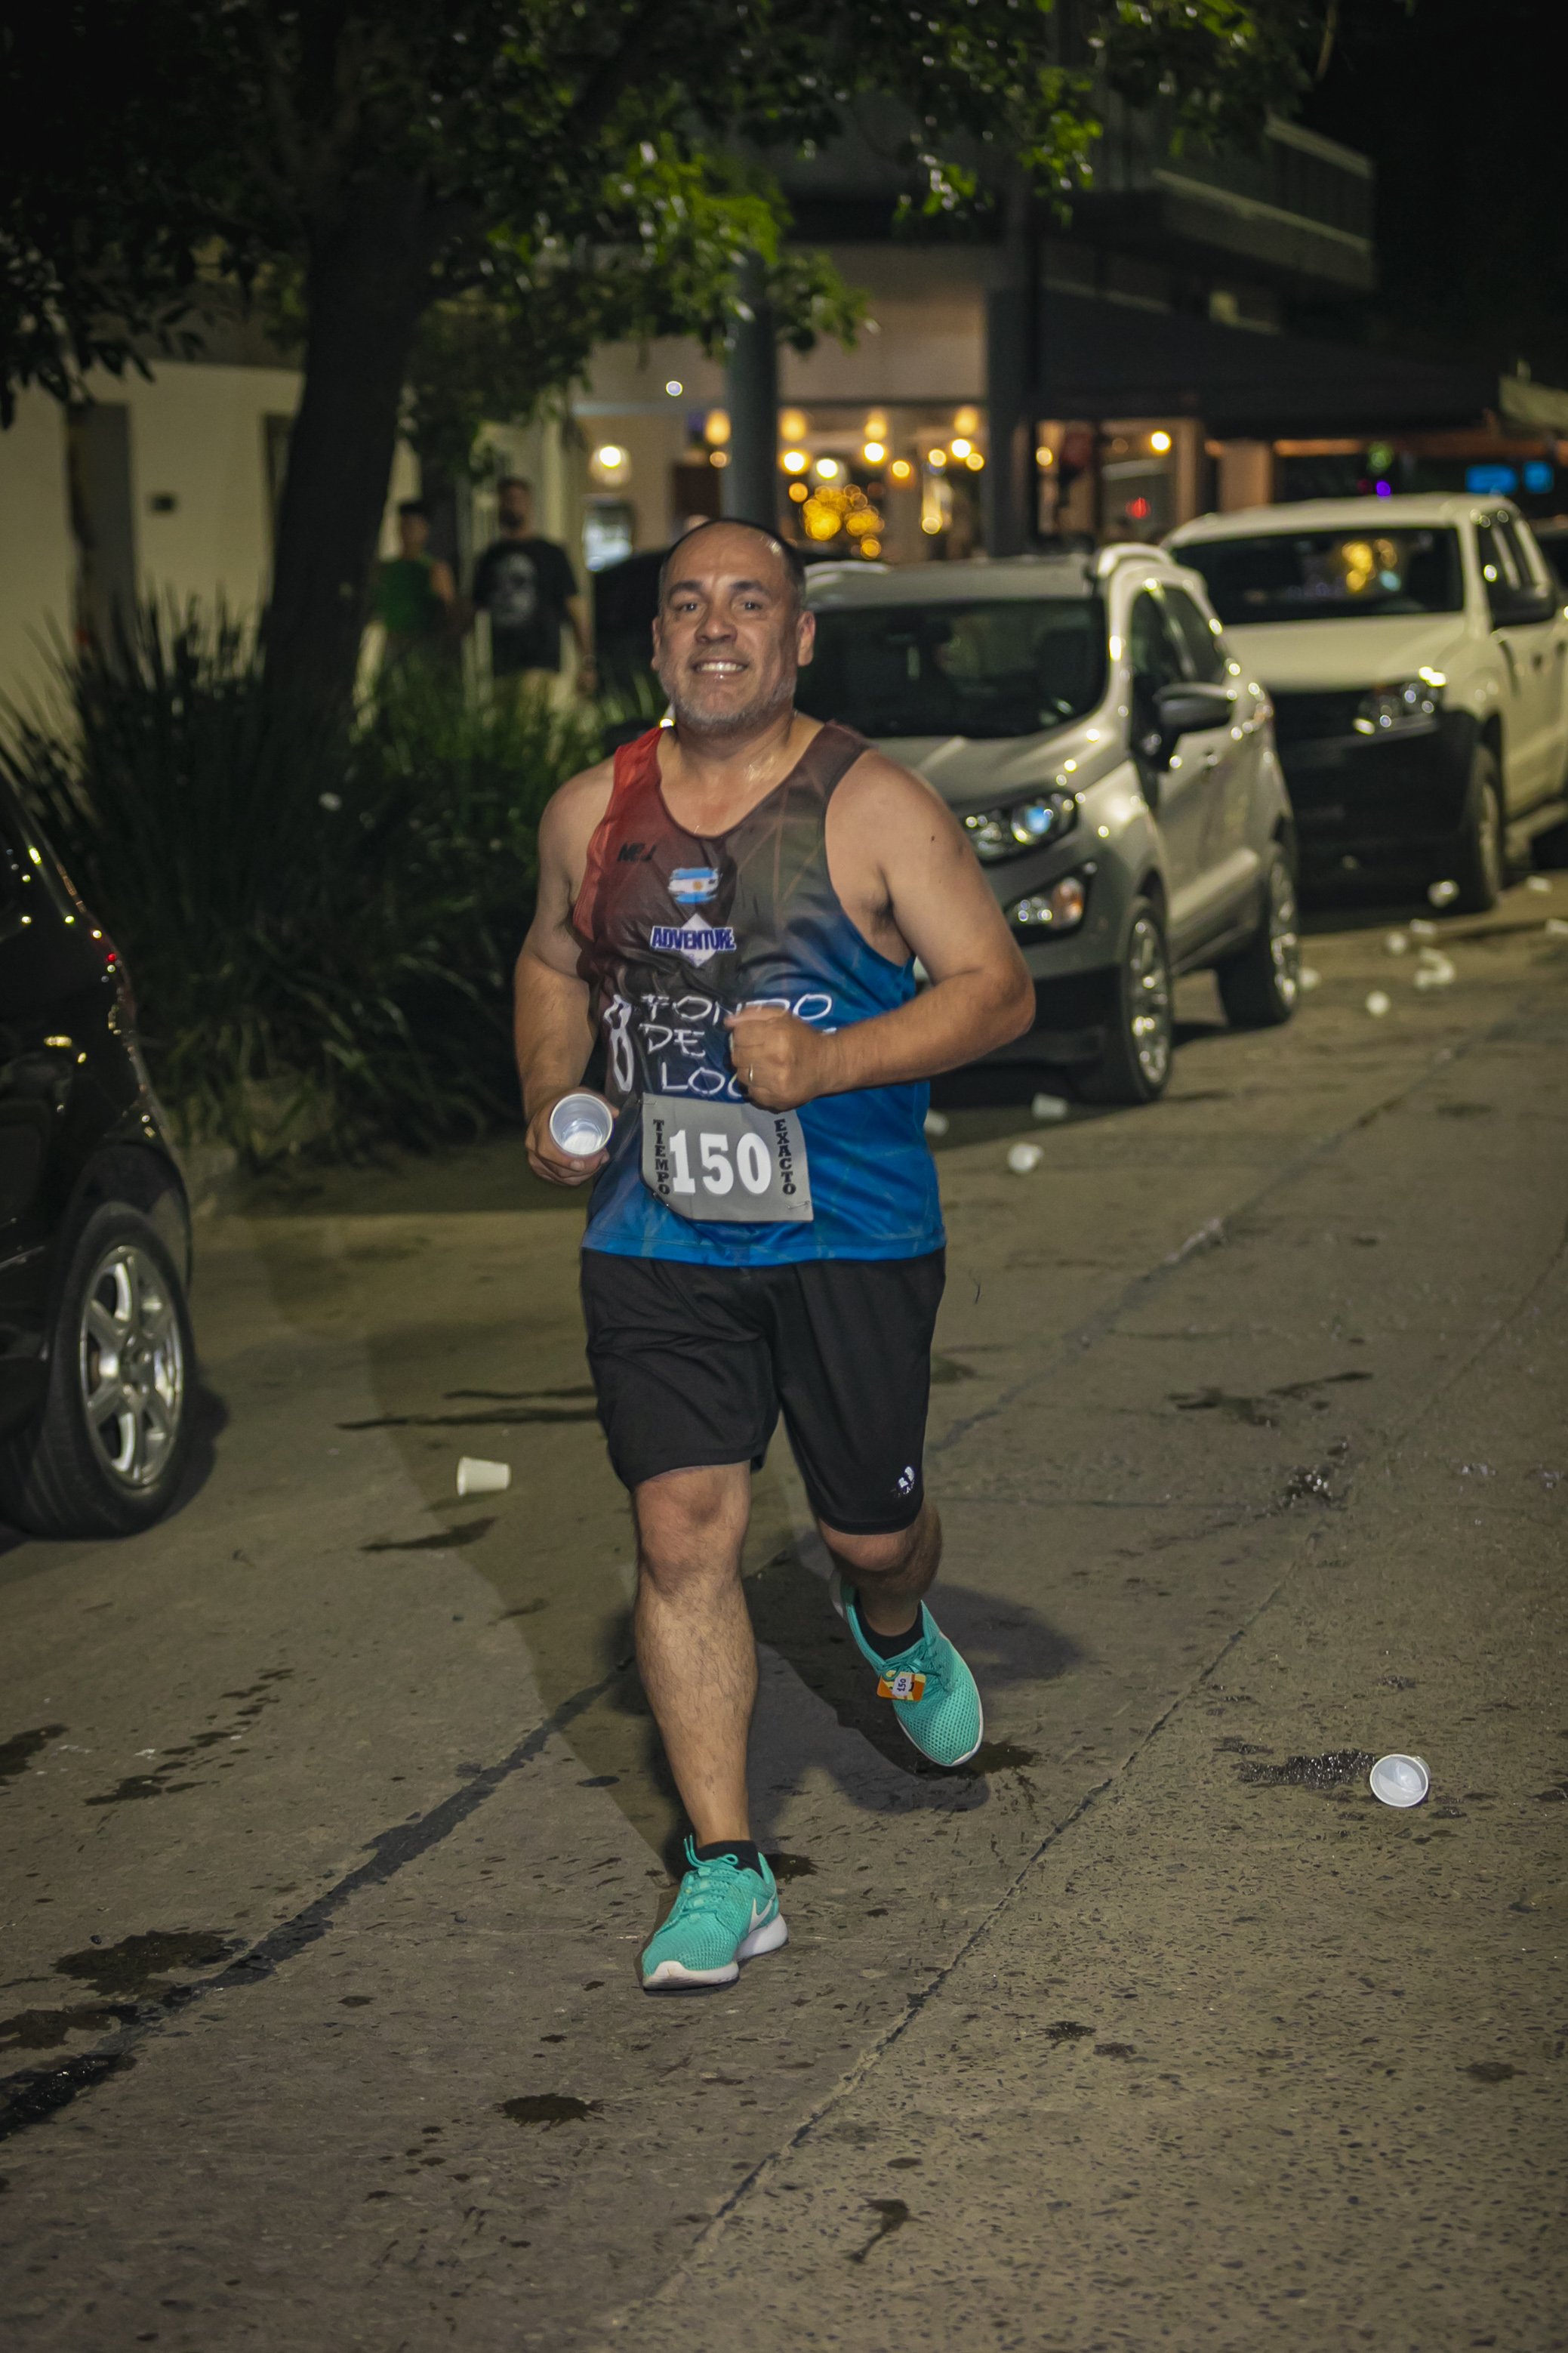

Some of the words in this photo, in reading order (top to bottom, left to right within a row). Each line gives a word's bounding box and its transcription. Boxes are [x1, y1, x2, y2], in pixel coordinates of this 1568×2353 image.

[651, 927, 735, 950] ADVENTURE
[639, 1022, 705, 1057] DE
[652, 1118, 670, 1195] TIEMPO
[669, 1130, 772, 1195] 150
[774, 1118, 796, 1195] EXACTO
[897, 1678, 907, 1692] 150
